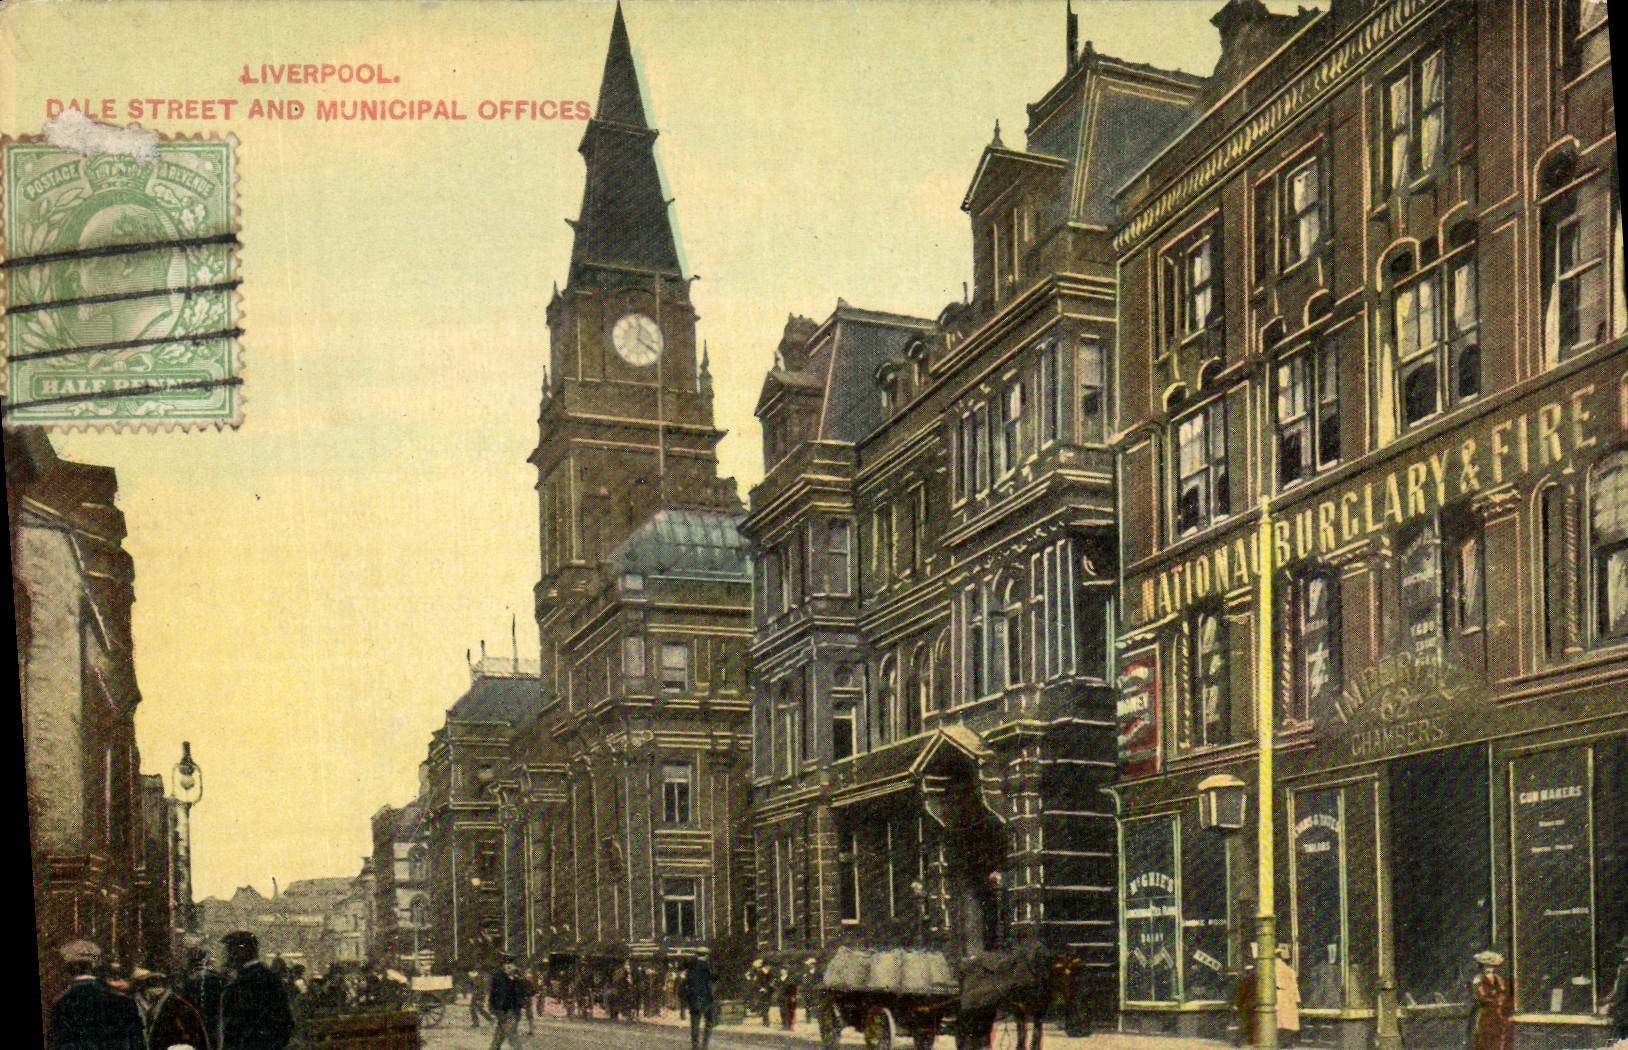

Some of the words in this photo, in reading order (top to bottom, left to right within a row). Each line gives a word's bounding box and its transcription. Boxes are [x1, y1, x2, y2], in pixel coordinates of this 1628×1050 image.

[26, 163, 78, 197] POSTAGE
[168, 165, 214, 198] REVENUE
[41, 379, 107, 395] HALF
[1275, 454, 1450, 569] BURGLARY
[1460, 438, 1481, 494] &
[1490, 384, 1597, 485] FIRE
[1351, 716, 1445, 756] CHAMBERS
[1540, 785, 1583, 801] MAKERS
